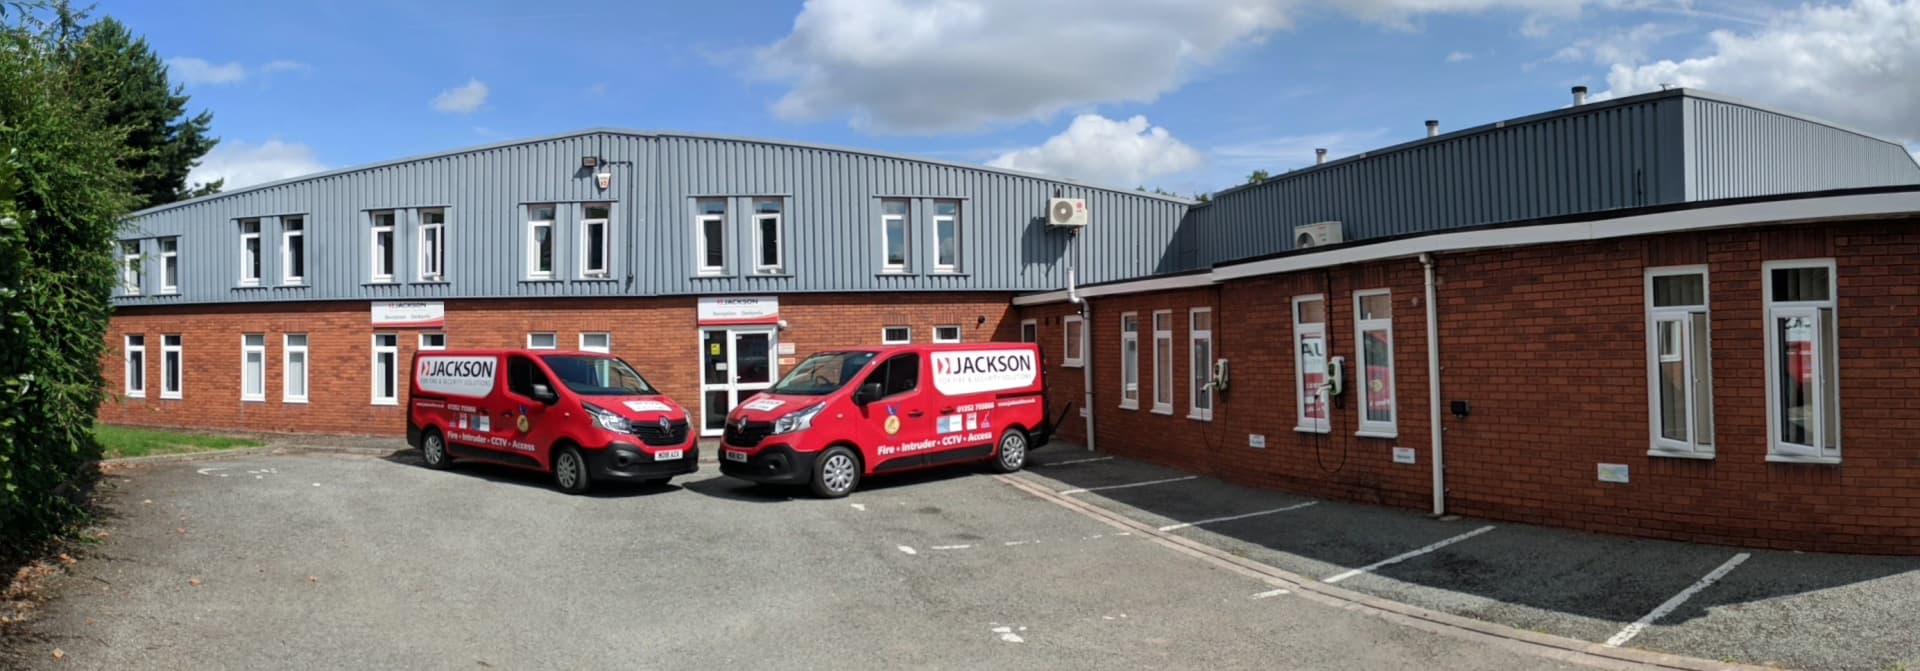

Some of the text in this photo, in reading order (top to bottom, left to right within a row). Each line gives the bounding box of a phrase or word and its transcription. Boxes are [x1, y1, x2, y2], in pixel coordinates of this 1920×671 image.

[430, 360, 493, 377] JACKSON
[952, 354, 1031, 375] JACKSON
[448, 431, 536, 451] Fire Intruder CCTV Access
[877, 432, 992, 455] Fire Intruder CCTV Access
